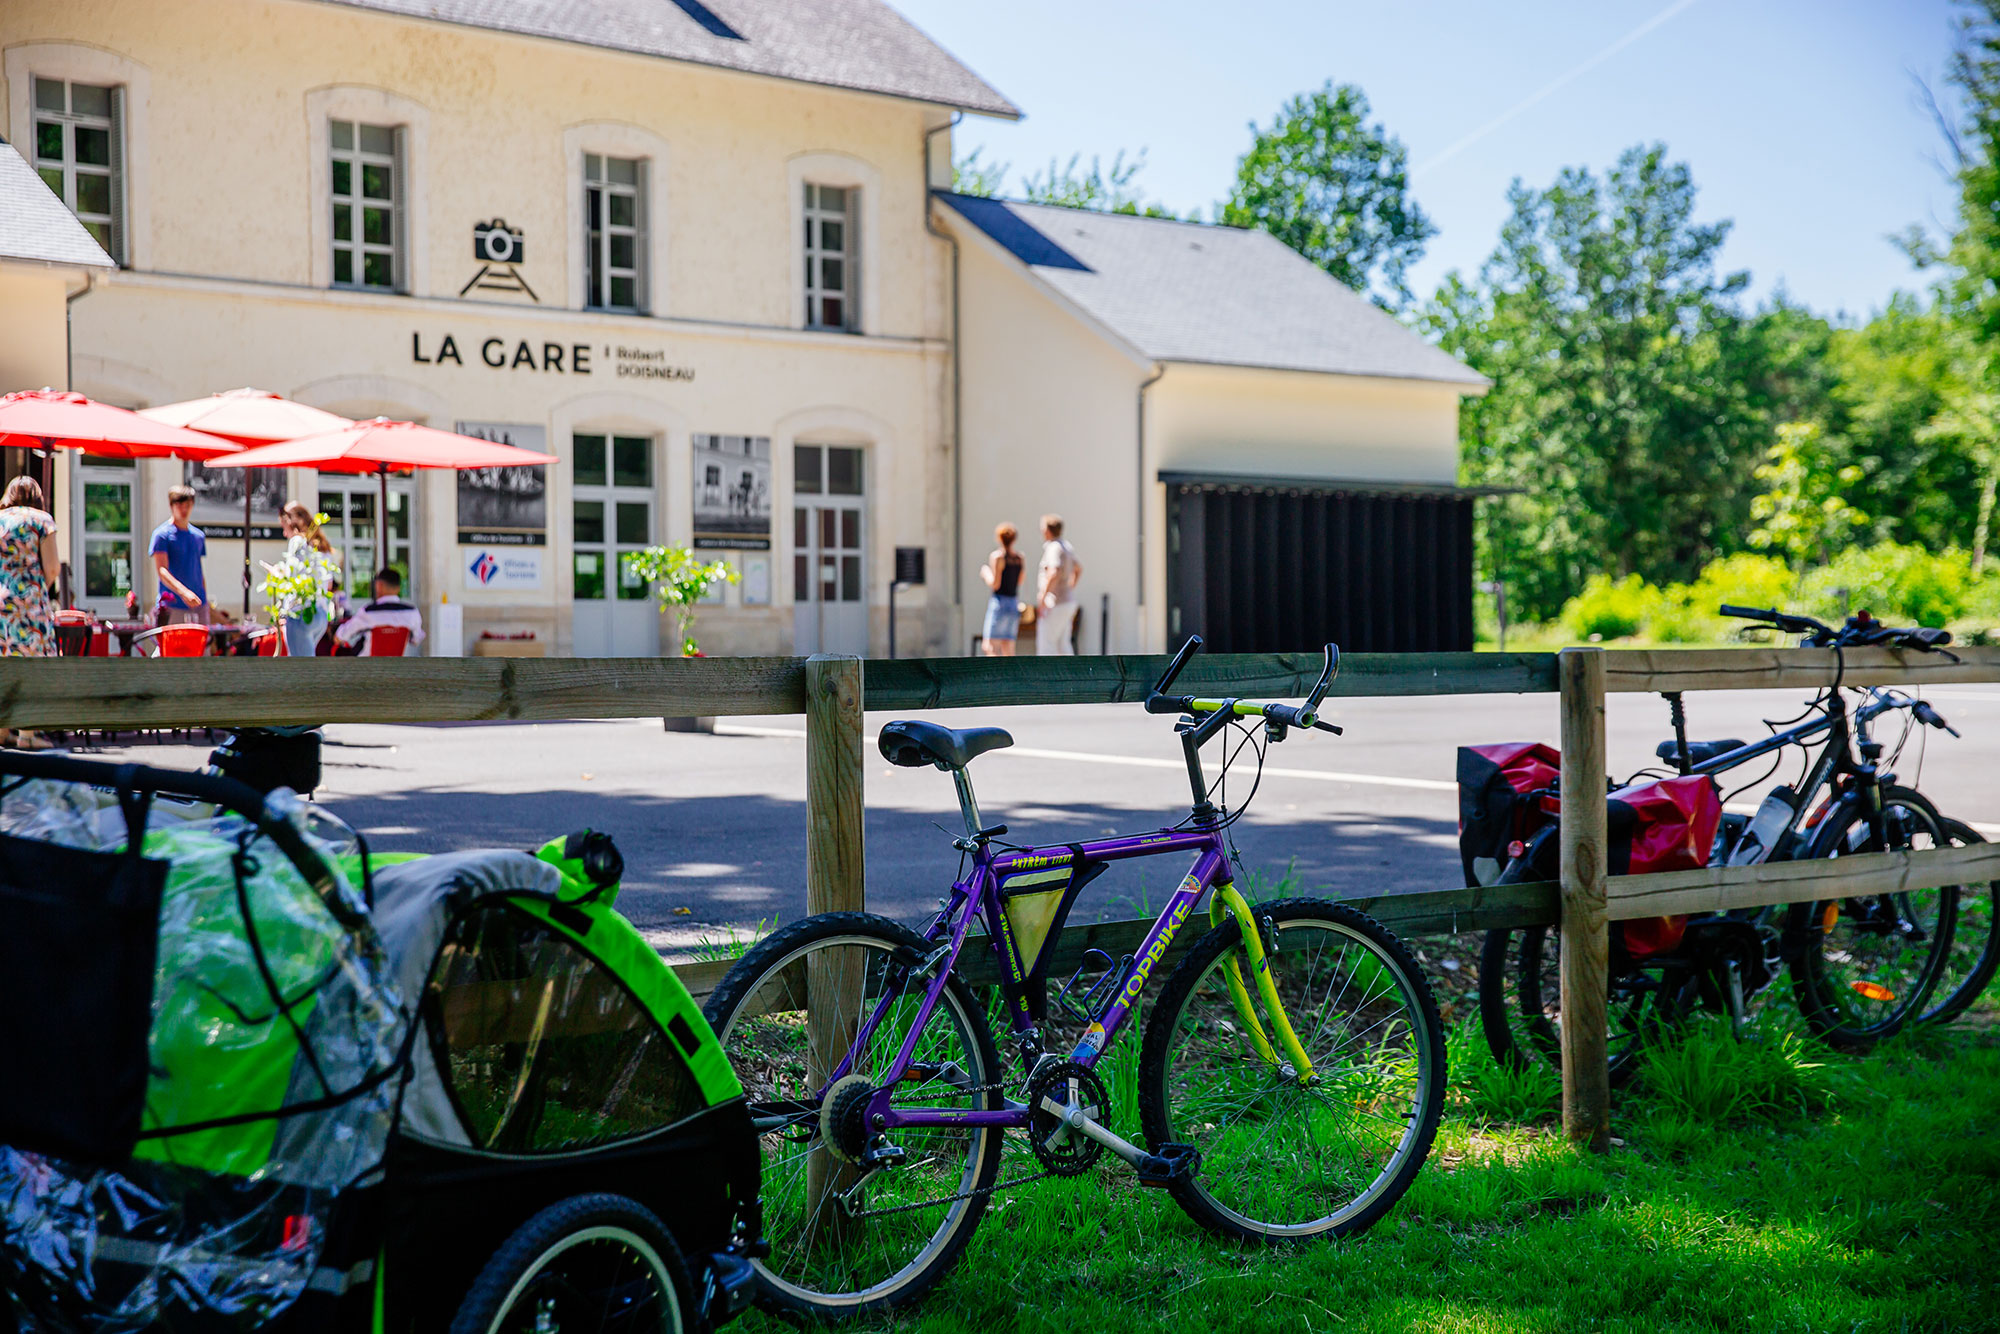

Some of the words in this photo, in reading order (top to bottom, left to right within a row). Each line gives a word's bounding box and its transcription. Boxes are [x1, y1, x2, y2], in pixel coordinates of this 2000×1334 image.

[412, 332, 463, 367] LA
[482, 338, 592, 374] GARE
[616, 345, 665, 361] Robert
[616, 363, 696, 381] DOISNEAU
[1011, 855, 1048, 869] EXTREM
[1113, 899, 1193, 1010] TOPBIKE
